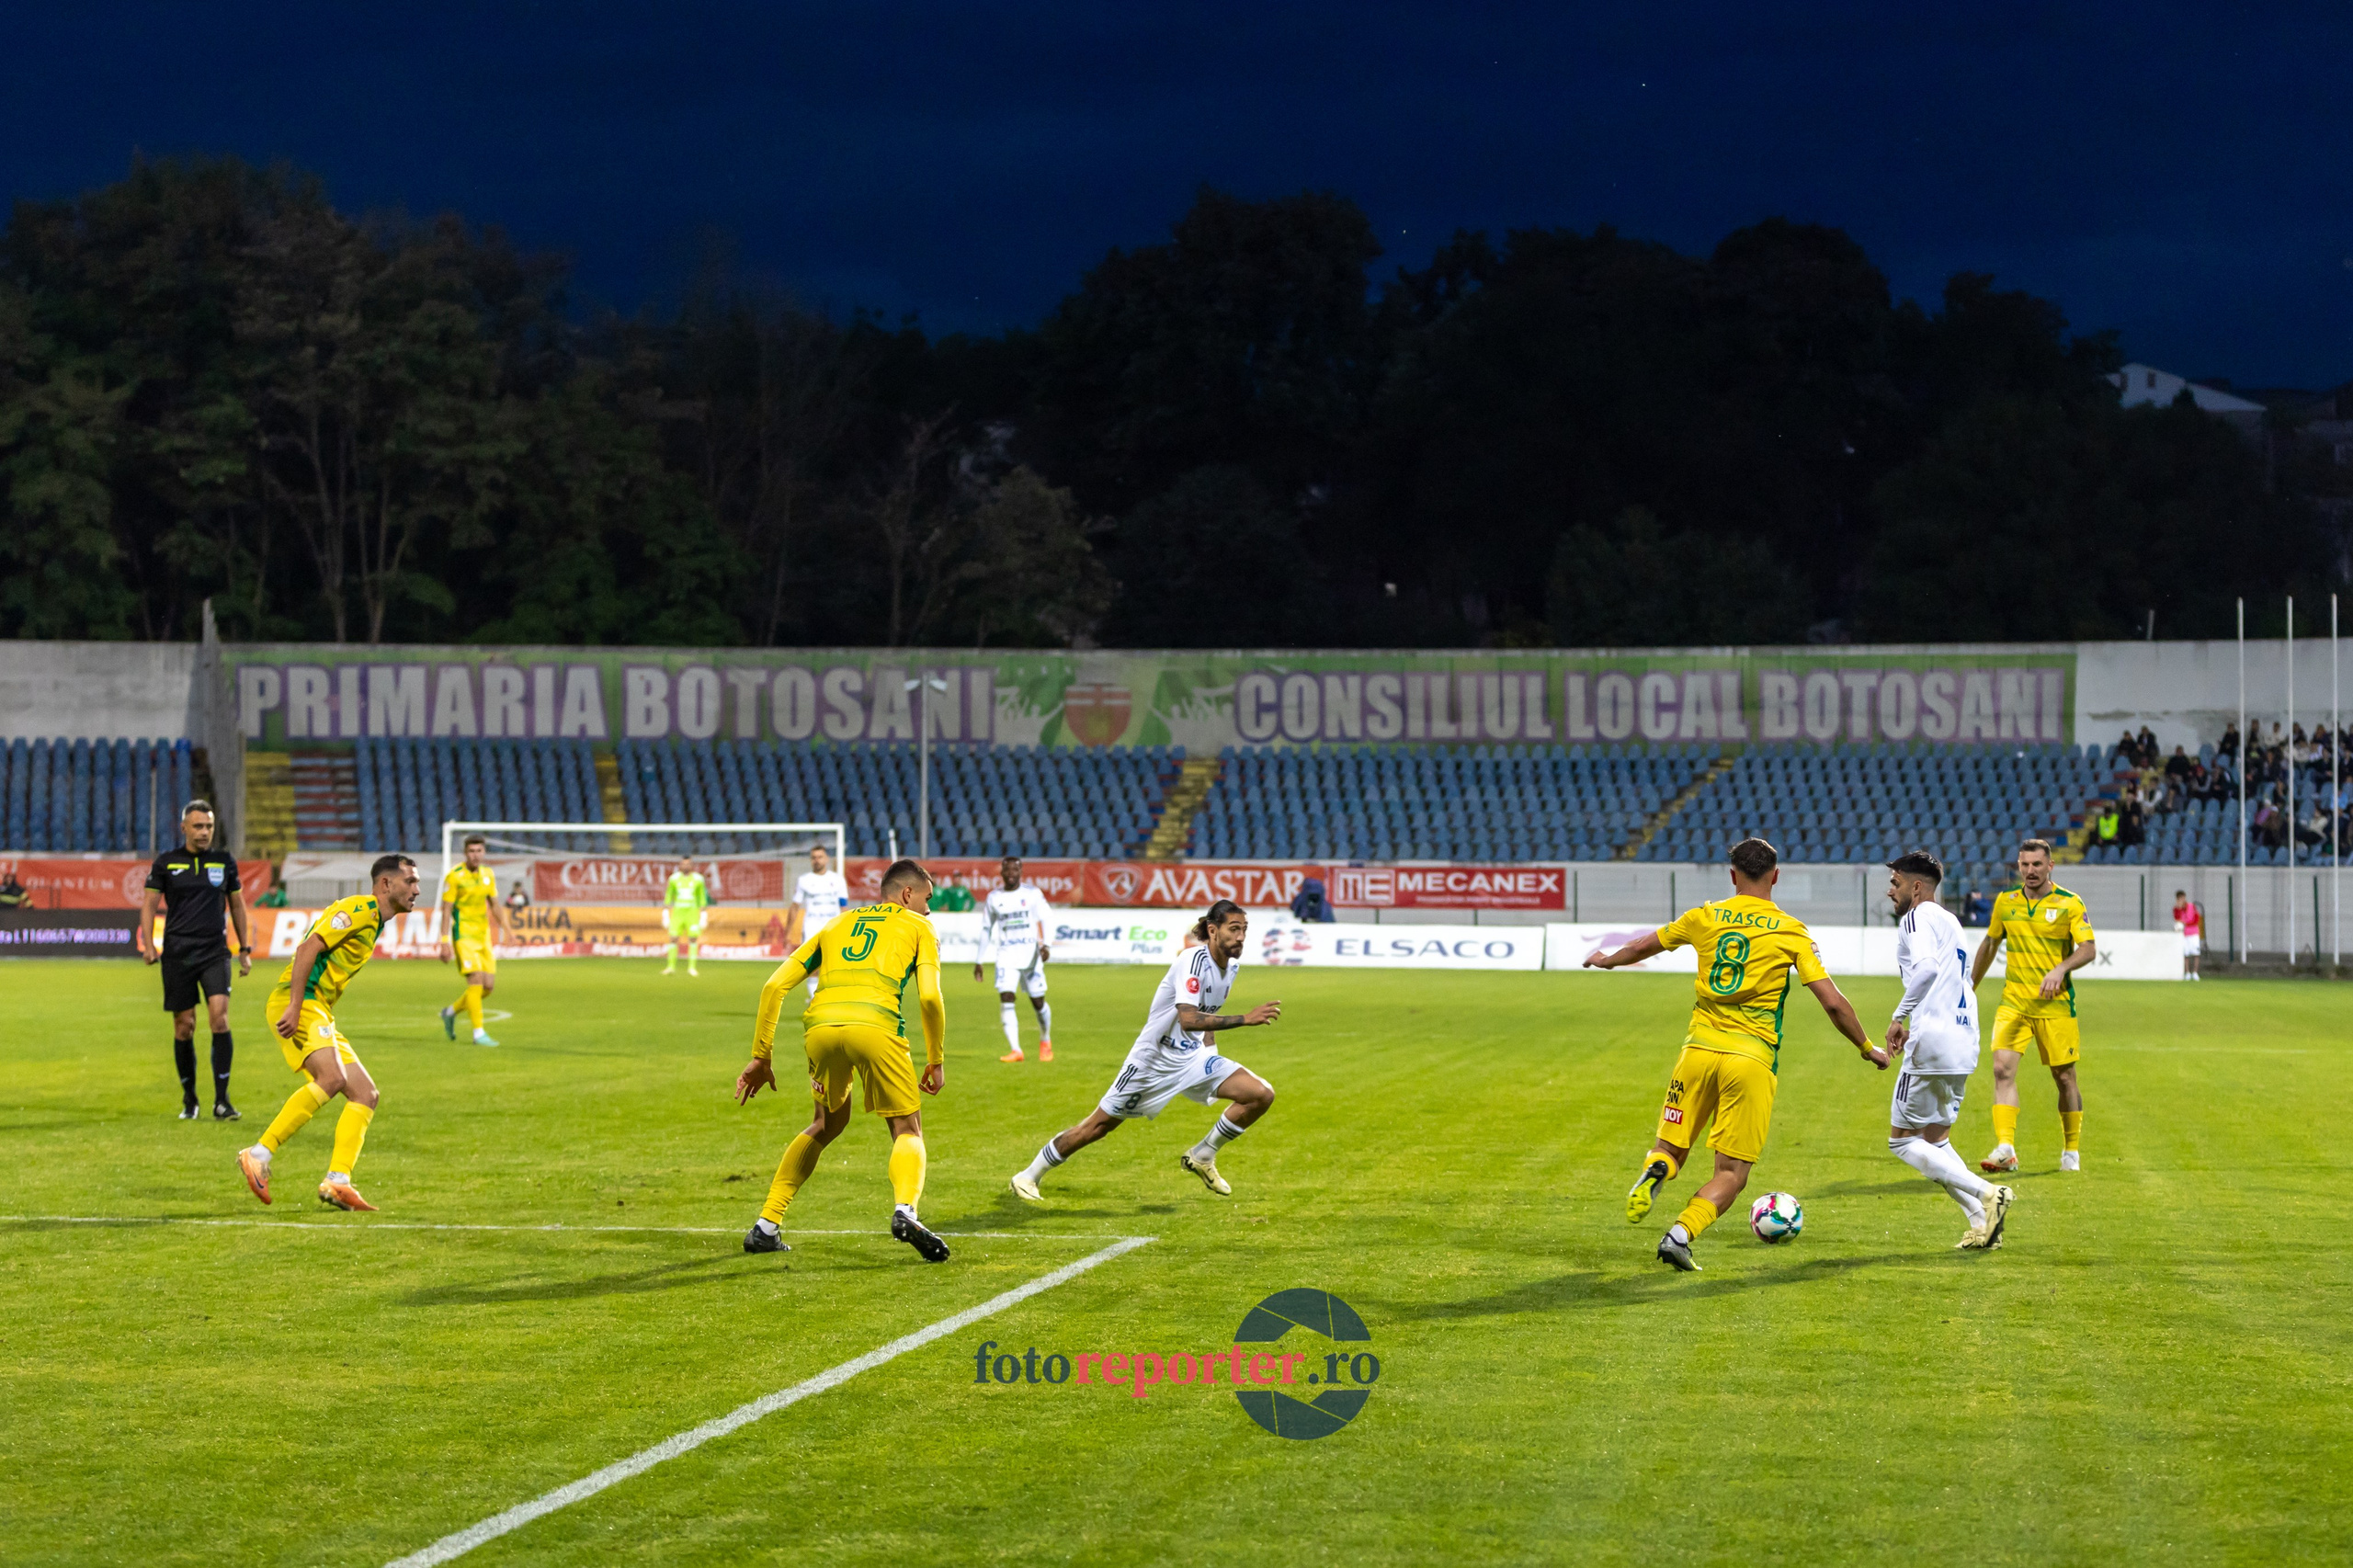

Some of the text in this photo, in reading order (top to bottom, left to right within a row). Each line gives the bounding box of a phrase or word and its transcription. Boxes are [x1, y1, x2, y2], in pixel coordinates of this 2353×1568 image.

[238, 664, 994, 741] PRIMARIA BOTOSANI
[1237, 668, 2063, 742] CONSILIUL LOCAL BOTOSANI
[1398, 872, 1560, 892] MECANEX
[511, 908, 572, 929] SIKA
[1714, 908, 1780, 930] TRASCU
[842, 915, 887, 962] 5
[1055, 925, 1167, 940] Smart Eco
[1131, 942, 1163, 954] Plus
[1336, 938, 1515, 959] ELSACO
[1709, 931, 1750, 995] 8
[1124, 1093, 1142, 1110] 8
